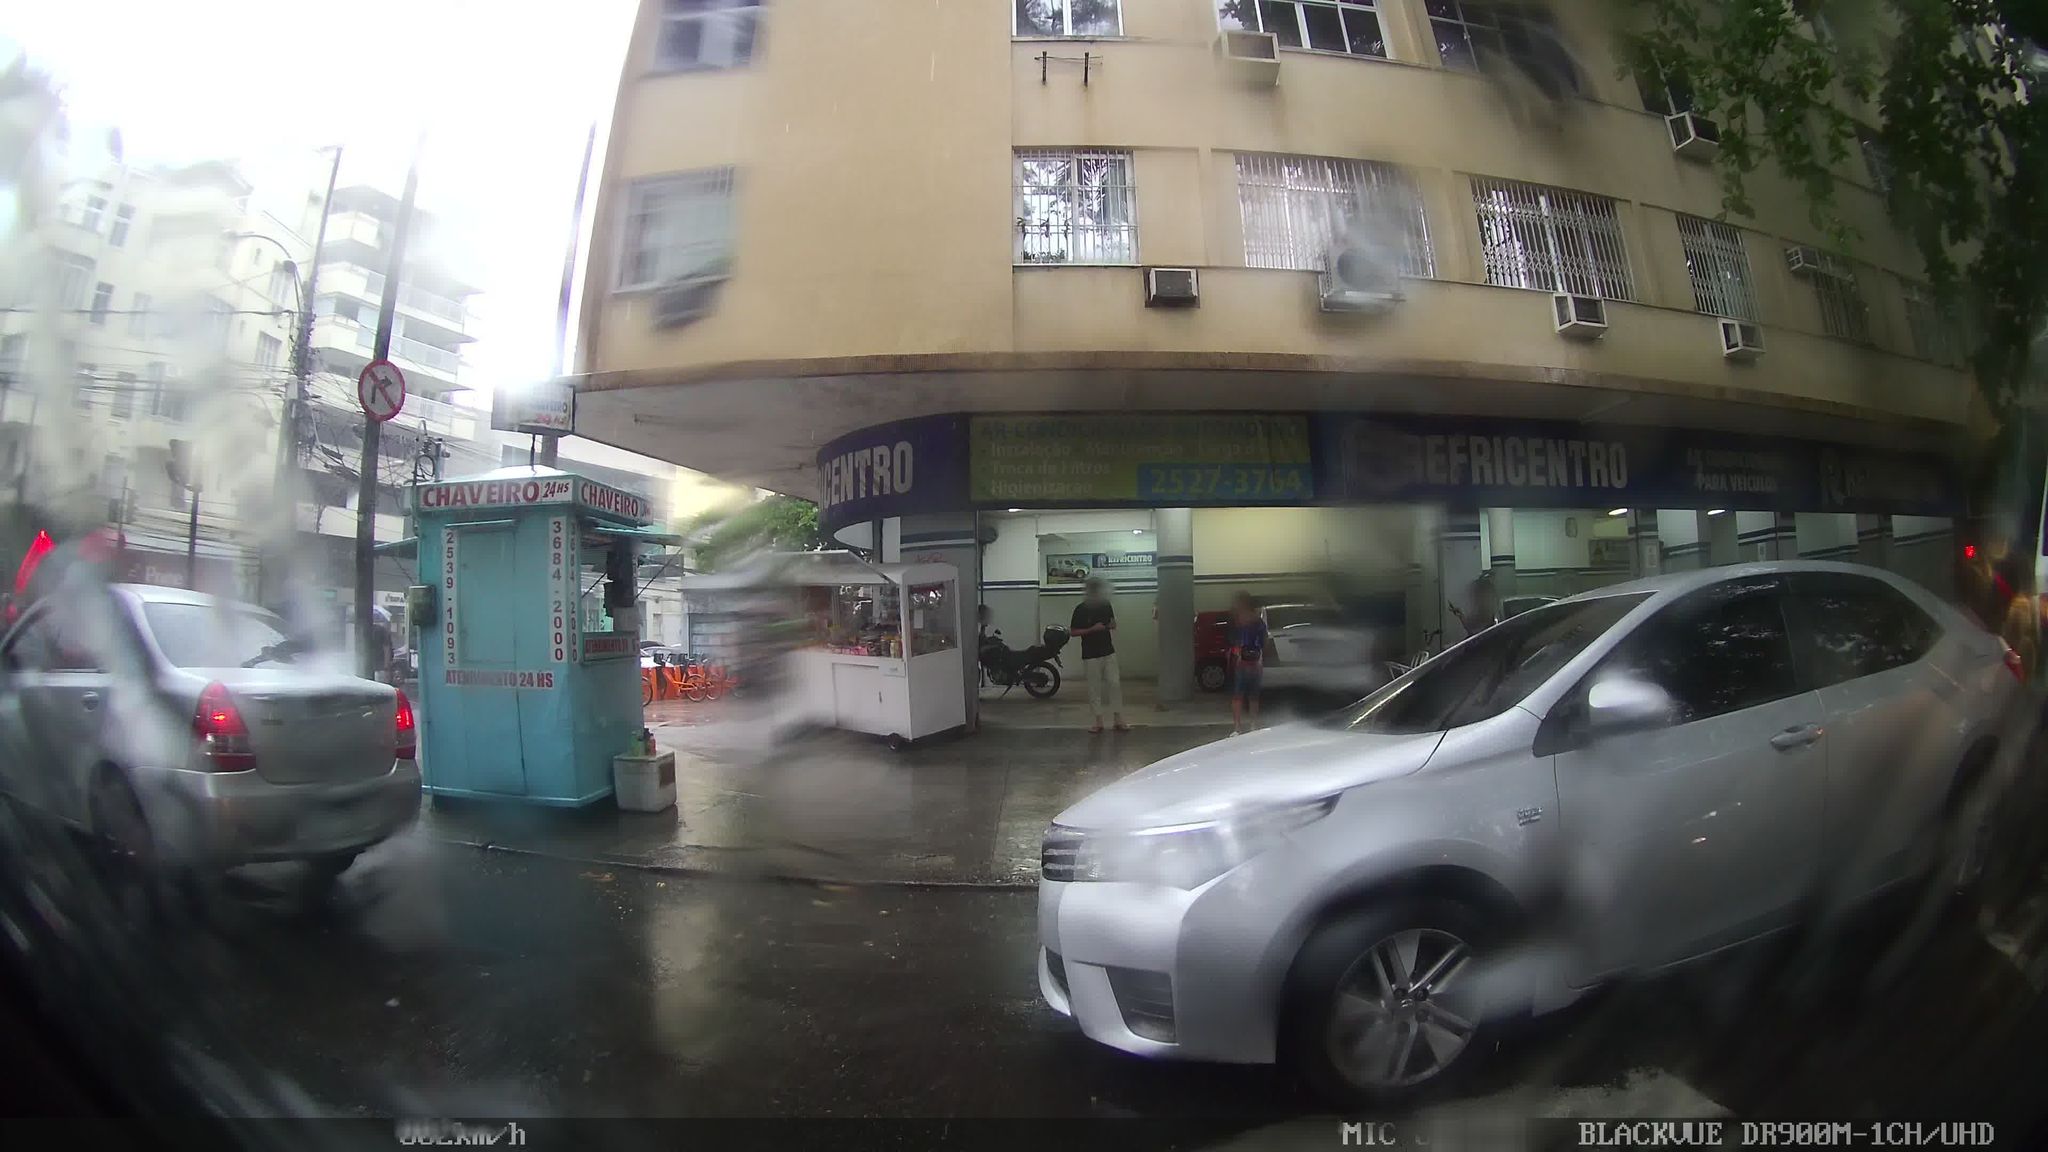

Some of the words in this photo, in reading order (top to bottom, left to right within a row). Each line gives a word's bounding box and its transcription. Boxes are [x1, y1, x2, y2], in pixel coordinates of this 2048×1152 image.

[422, 481, 540, 507] CHAVEIRO
[1151, 468, 1302, 495] 2527-3764
[581, 481, 639, 517] CHAVEIRO
[446, 669, 517, 687] ATENTO
[519, 672, 534, 687] 24
[536, 672, 553, 688] HS
